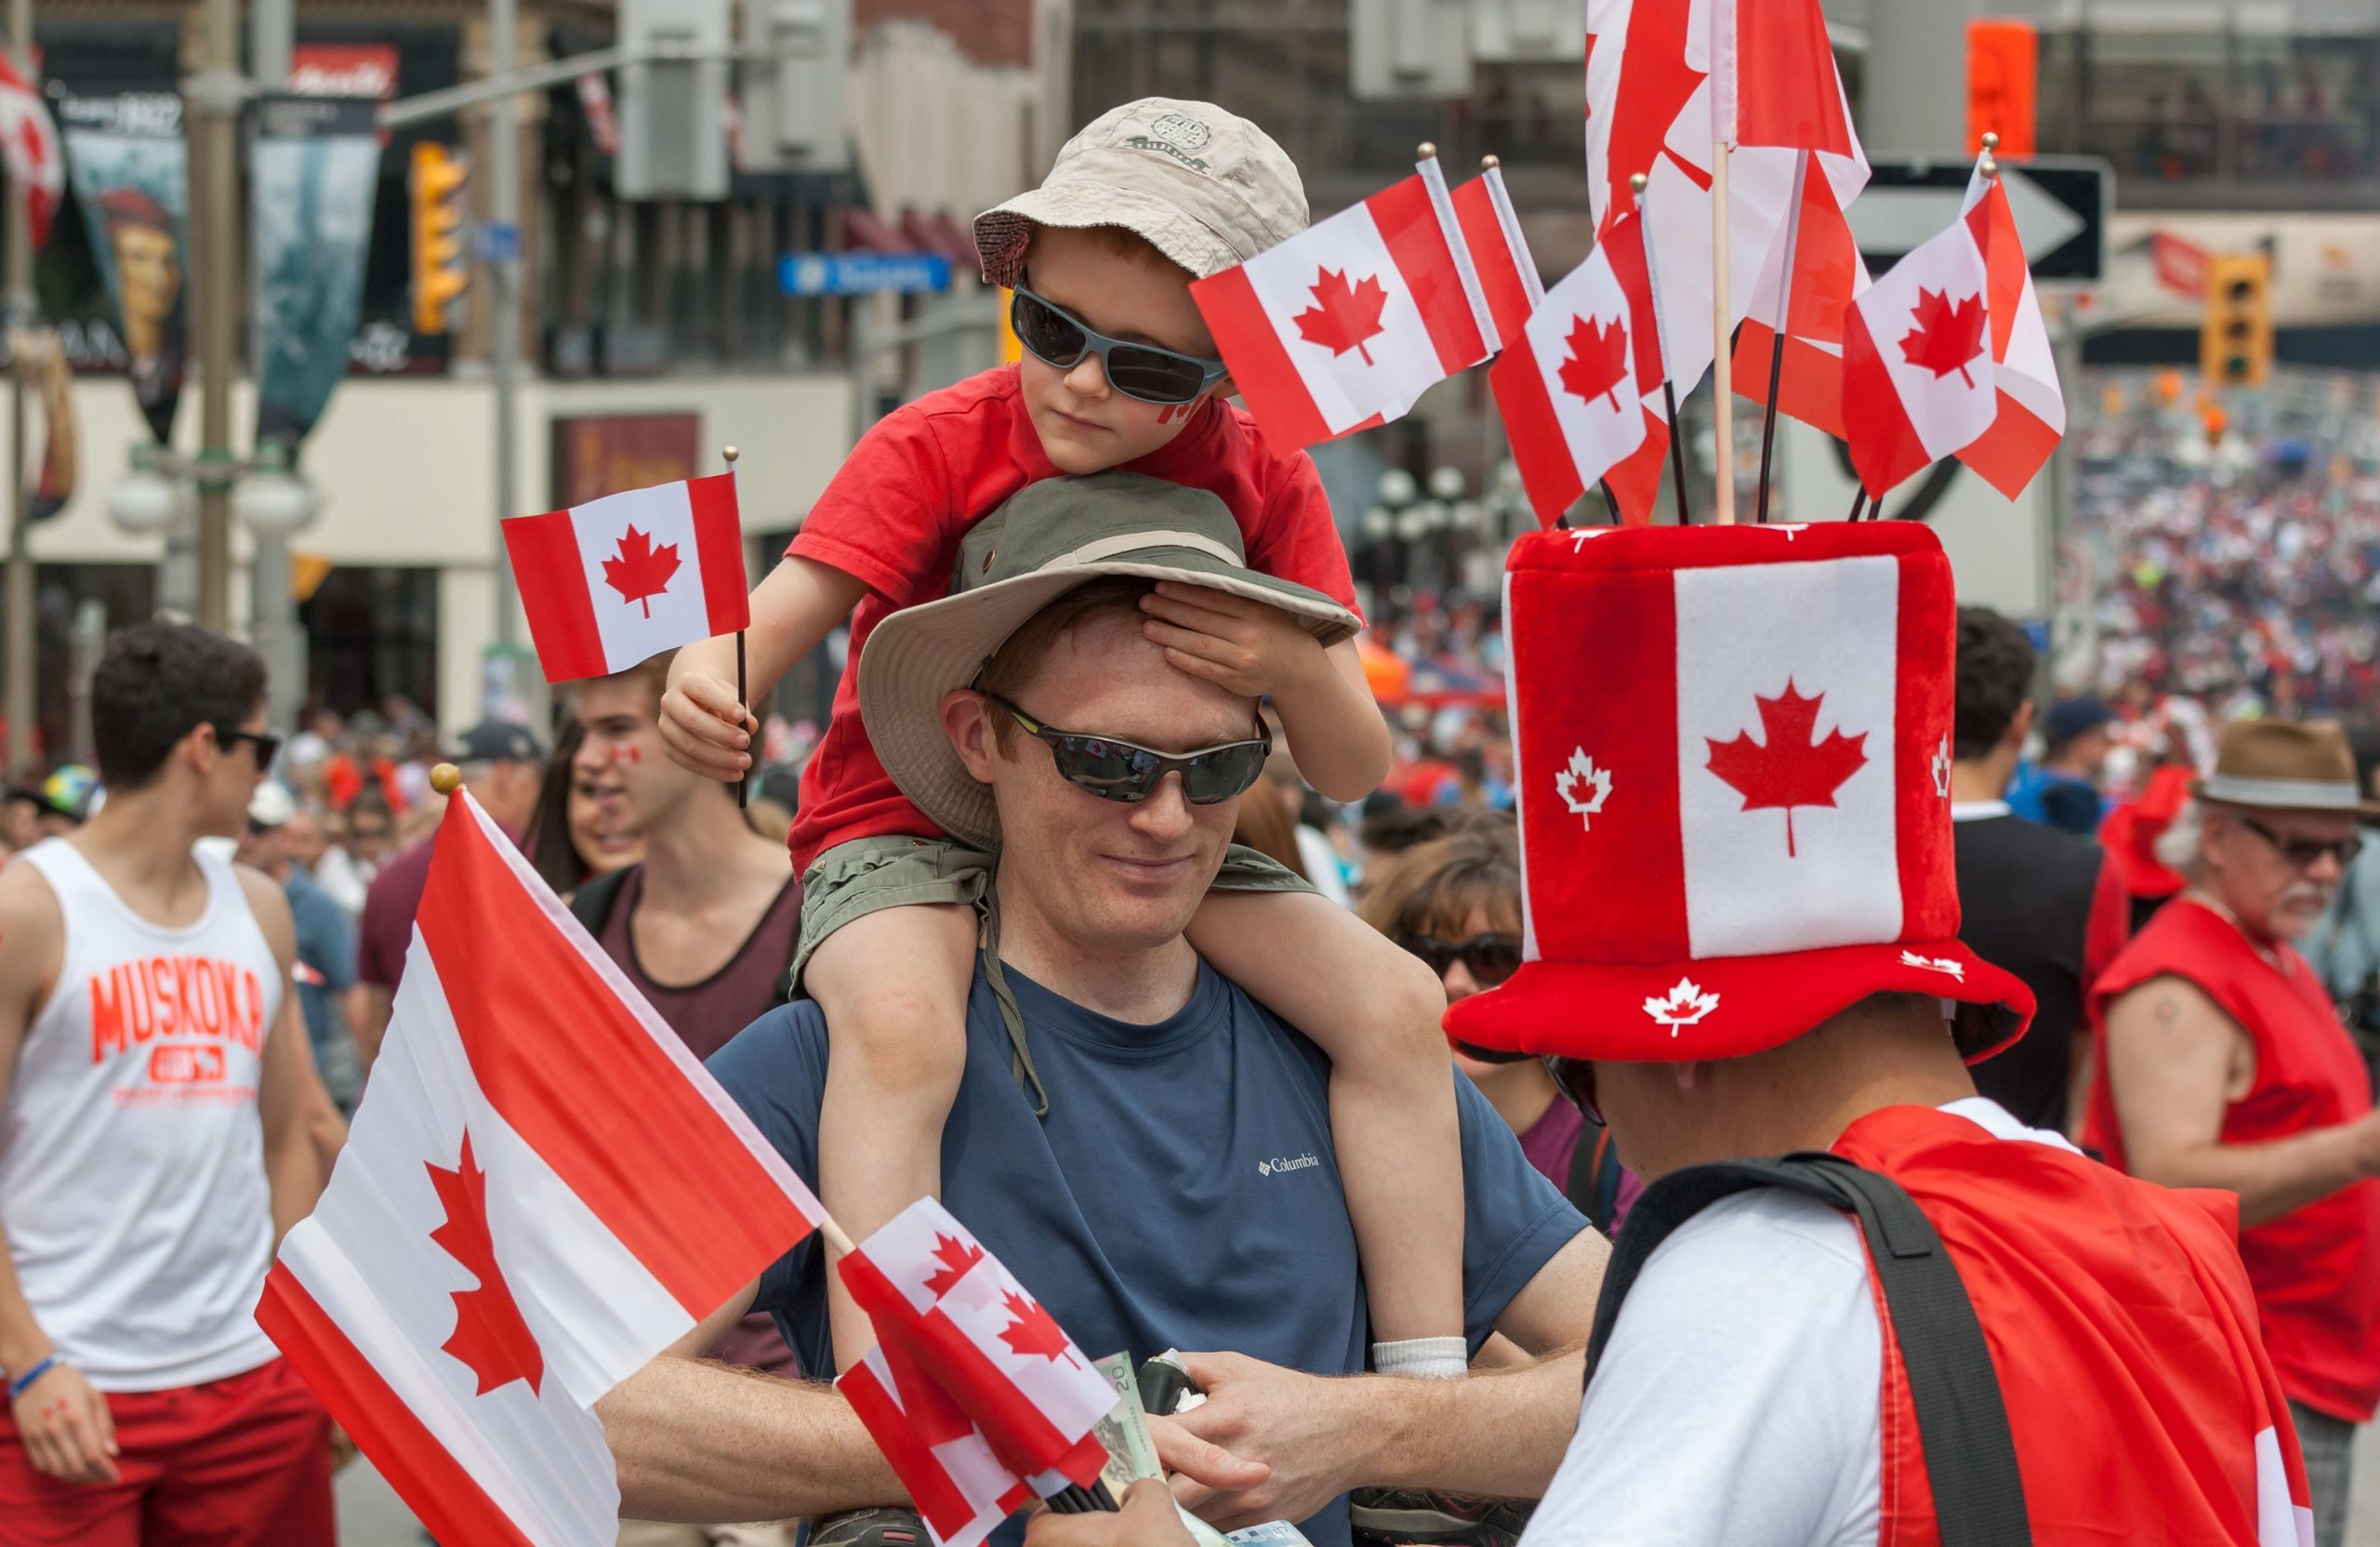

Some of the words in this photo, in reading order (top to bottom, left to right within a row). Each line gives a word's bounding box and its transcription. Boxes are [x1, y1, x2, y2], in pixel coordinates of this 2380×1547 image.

[90, 955, 264, 1064] MUSKOKA
[1270, 1153, 1319, 1172] Columbia
[1112, 1366, 1130, 1393] 20
